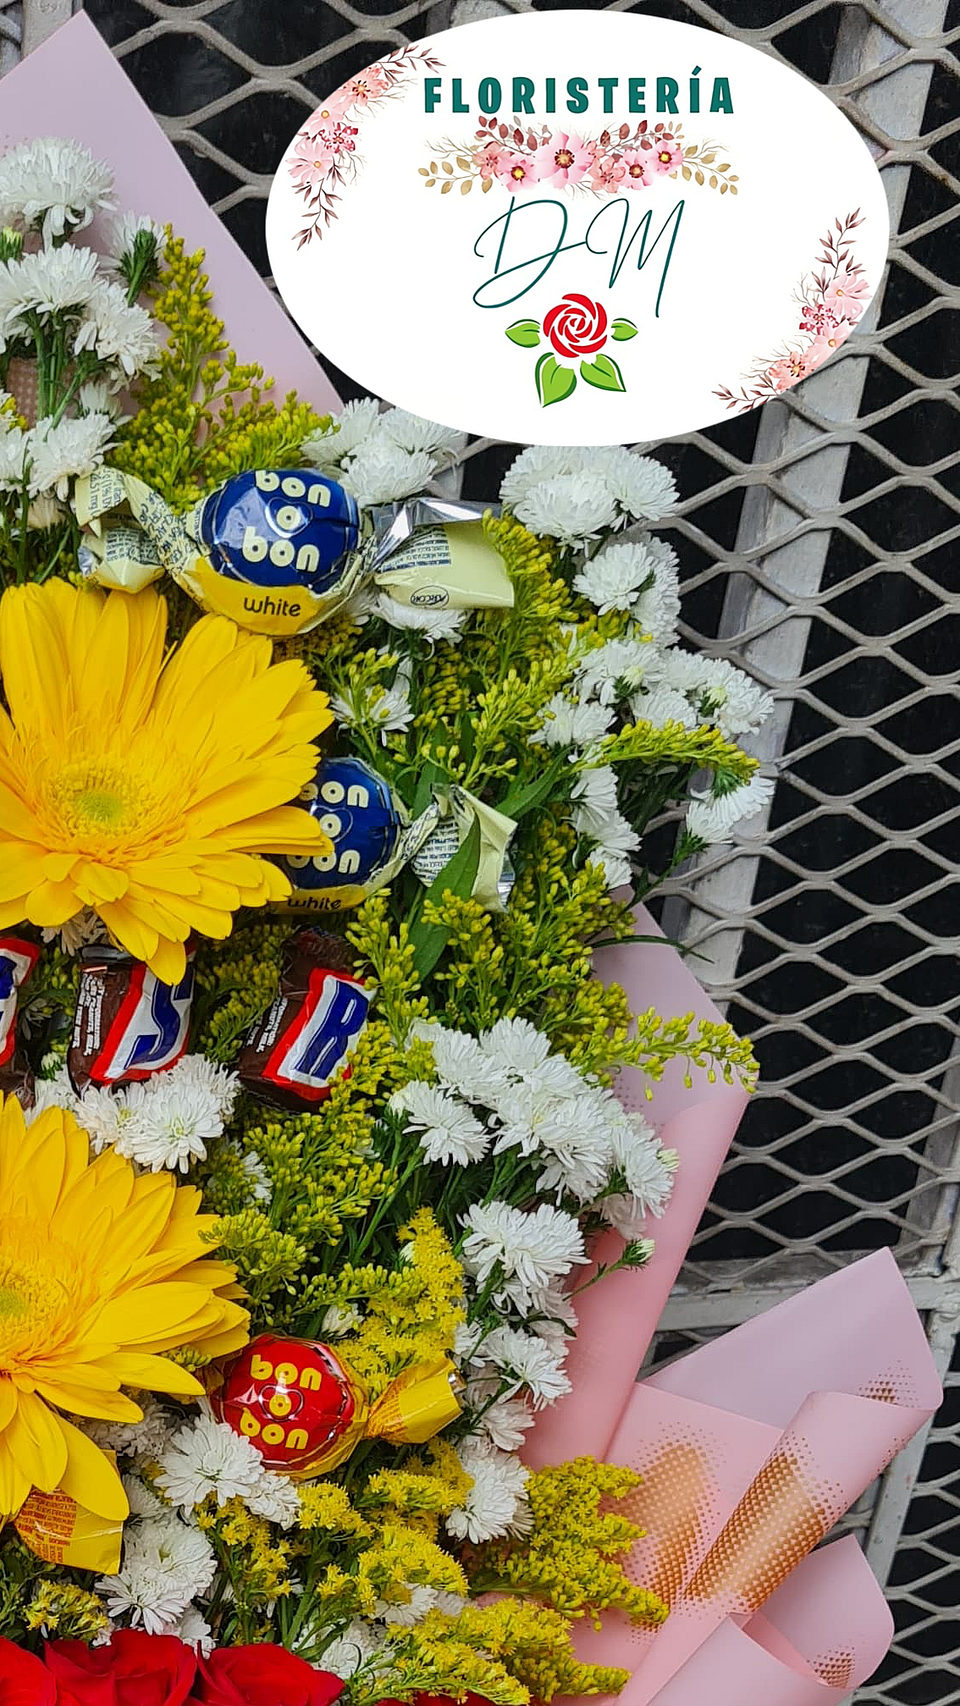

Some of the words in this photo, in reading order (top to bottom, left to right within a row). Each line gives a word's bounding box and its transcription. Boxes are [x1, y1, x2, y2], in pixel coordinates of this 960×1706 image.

[255, 470, 331, 507] bon
[276, 505, 301, 530] o
[242, 526, 320, 572] bon
[243, 596, 301, 616] white
[287, 896, 341, 911] white
[294, 980, 369, 1080] R
[250, 1354, 322, 1391] bon
[269, 1393, 292, 1417] o
[240, 1407, 308, 1449] bon
